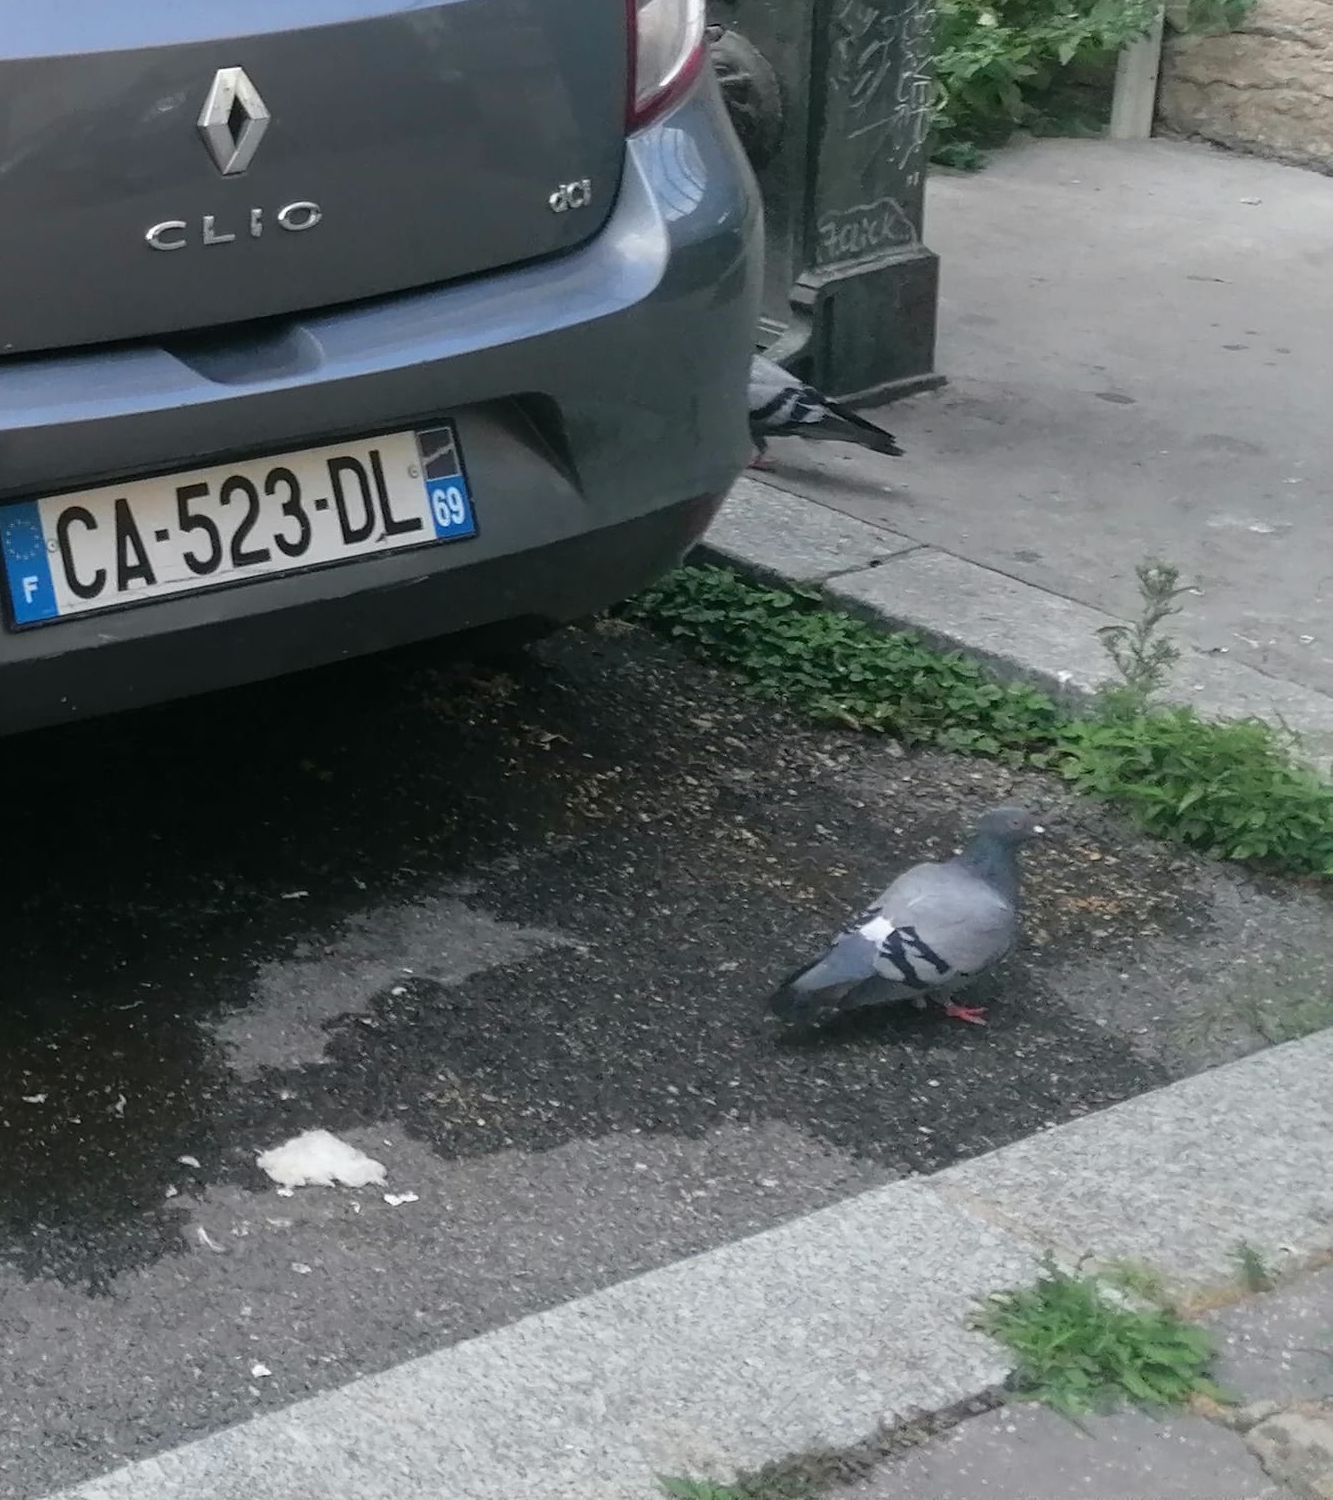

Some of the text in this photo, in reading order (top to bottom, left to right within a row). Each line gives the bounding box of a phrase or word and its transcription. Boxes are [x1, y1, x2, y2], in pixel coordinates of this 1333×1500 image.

[145, 201, 323, 250] CLIO
[56, 450, 423, 599] CA-523-DL
[433, 485, 466, 528] 69
[21, 575, 39, 604] F
